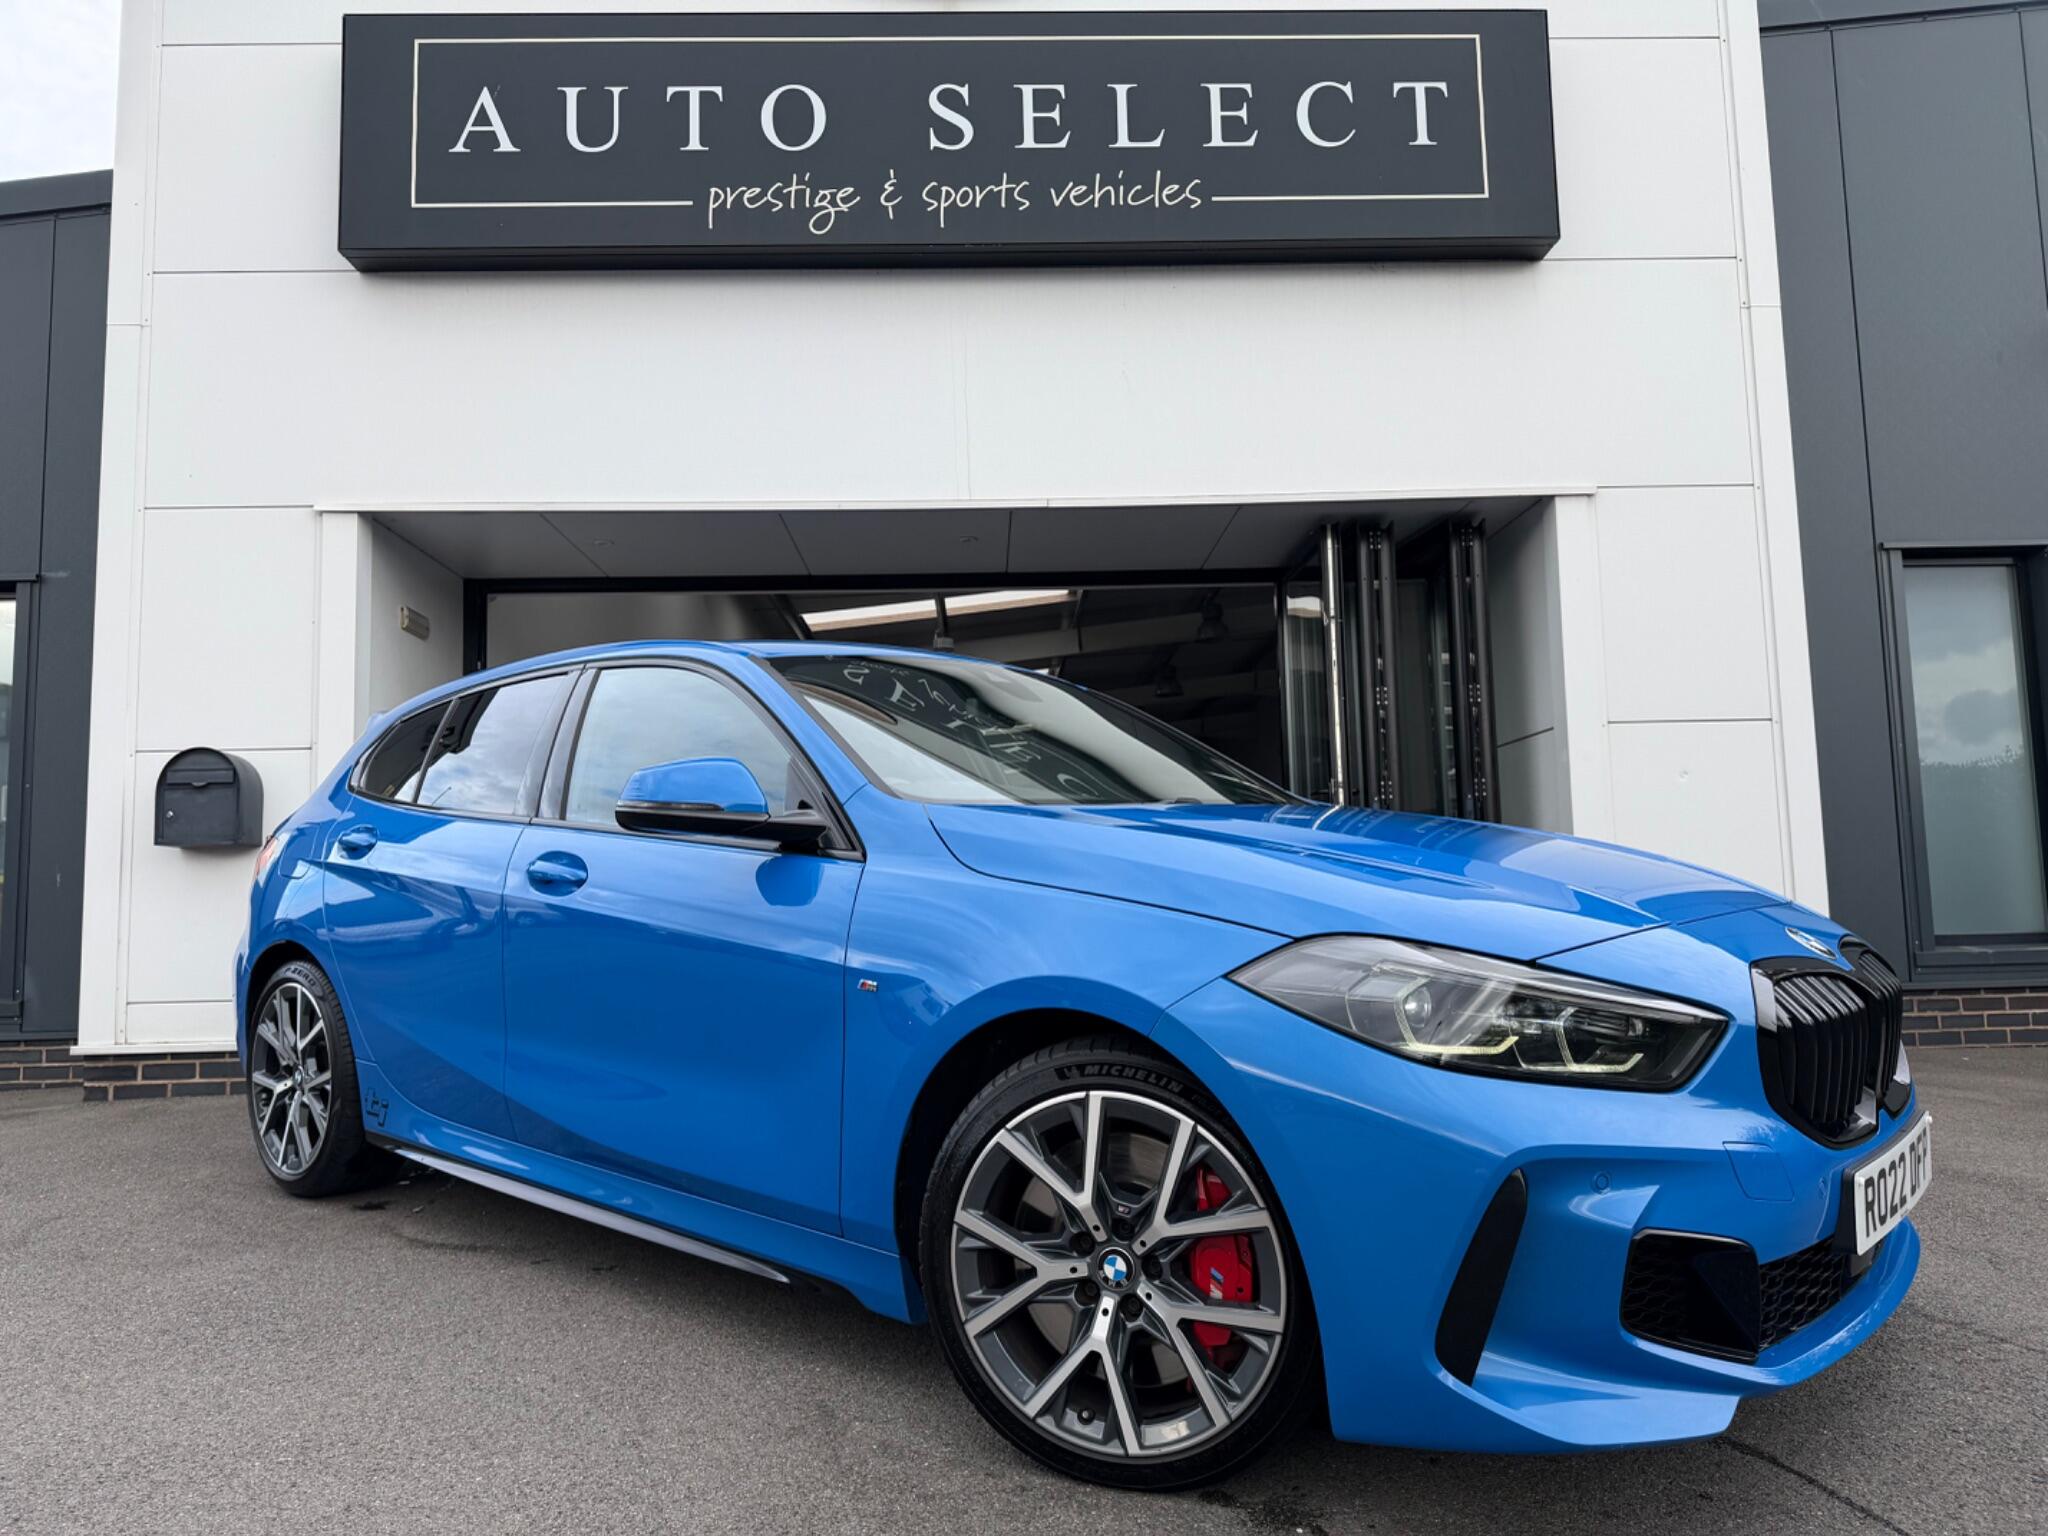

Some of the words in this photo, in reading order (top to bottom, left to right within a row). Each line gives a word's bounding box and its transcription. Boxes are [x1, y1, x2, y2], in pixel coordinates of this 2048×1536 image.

[448, 83, 828, 153] AUTO
[928, 80, 1449, 151] SELECT
[707, 173, 861, 235] prestige
[880, 169, 903, 219] &
[922, 172, 1031, 228] sports
[1050, 169, 1203, 210] vehicles
[1084, 1064, 1185, 1092] MICHELIN
[1864, 1151, 1907, 1237] RO22
